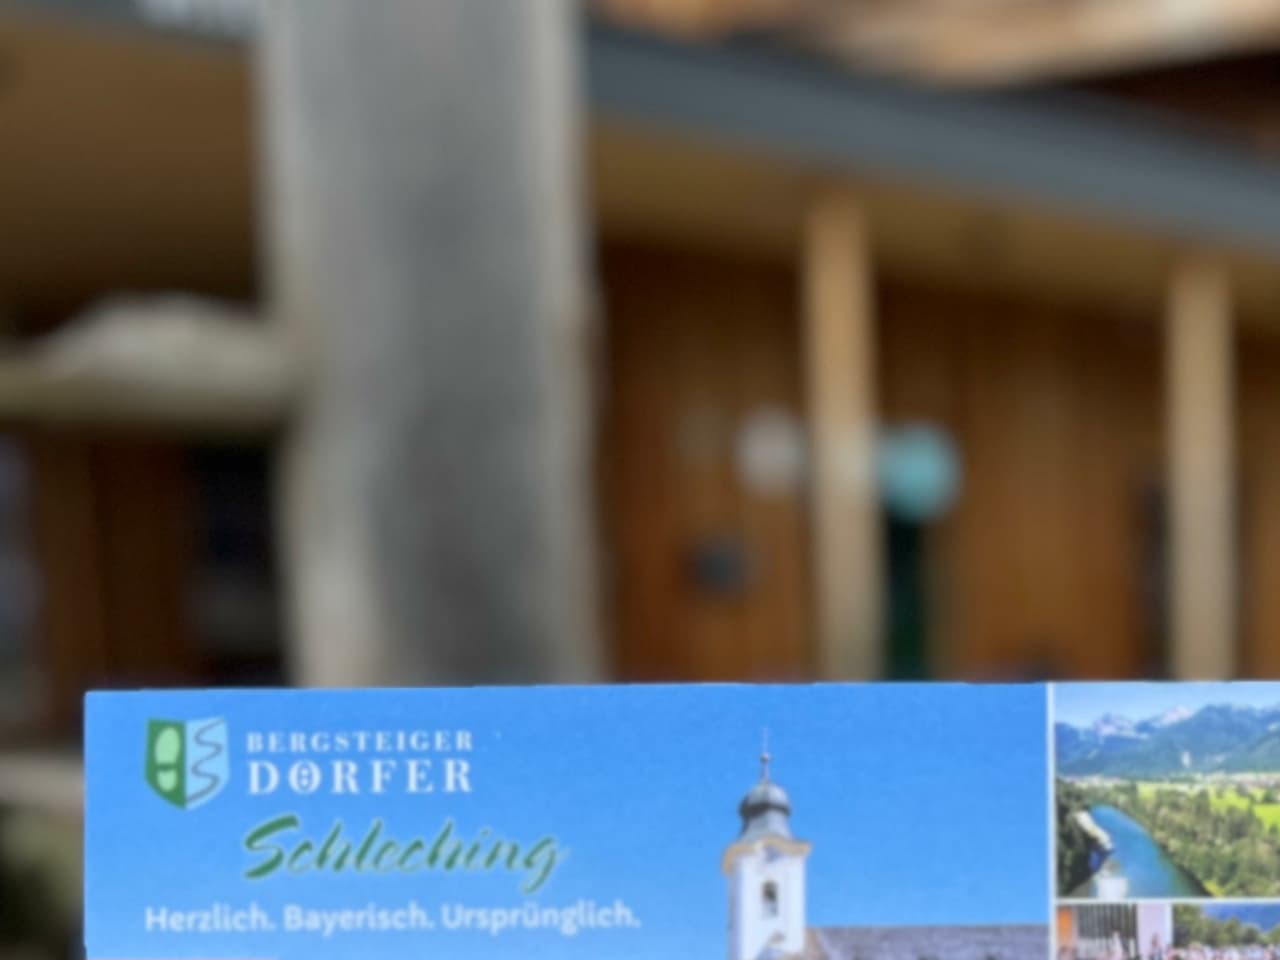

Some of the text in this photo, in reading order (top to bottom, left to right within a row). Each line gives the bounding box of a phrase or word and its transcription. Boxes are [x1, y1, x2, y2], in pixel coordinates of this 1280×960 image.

[247, 730, 473, 753] BERGSTEIGER
[243, 814, 569, 894] Schleching
[145, 901, 642, 938] Herzlich. Bayerisch. Ursprünglich.
